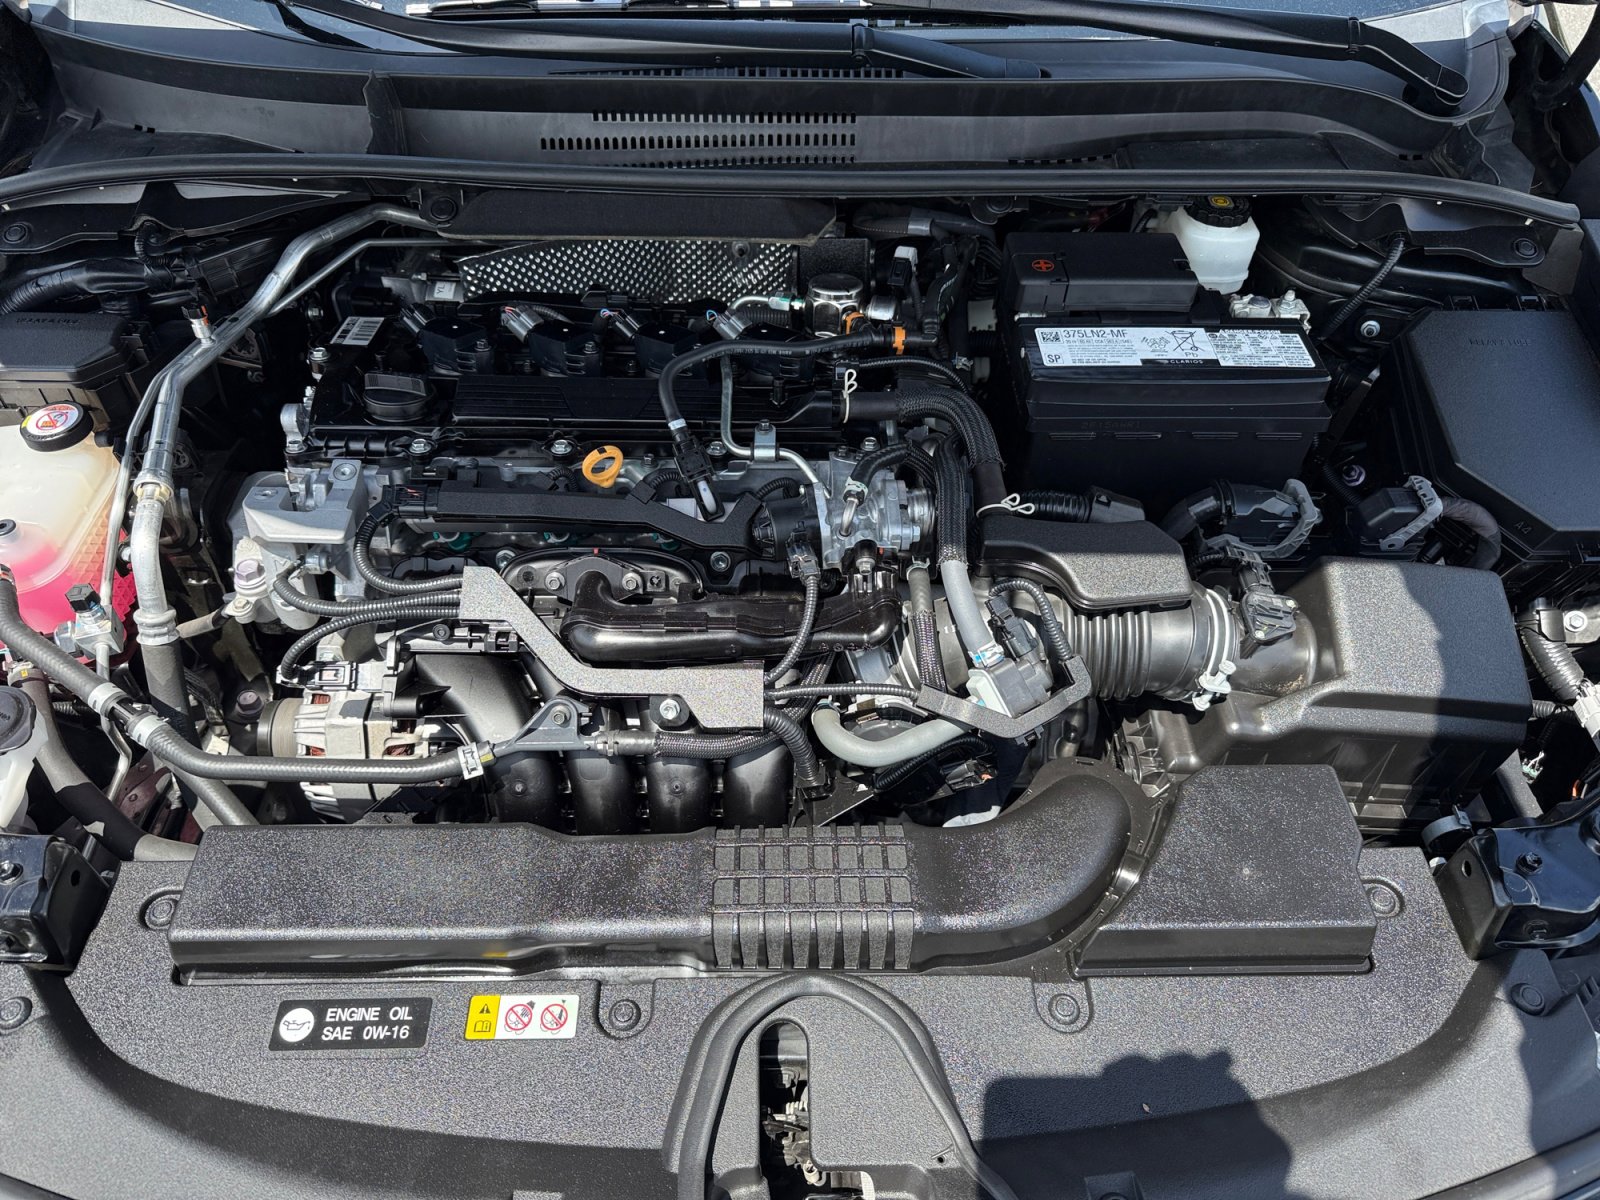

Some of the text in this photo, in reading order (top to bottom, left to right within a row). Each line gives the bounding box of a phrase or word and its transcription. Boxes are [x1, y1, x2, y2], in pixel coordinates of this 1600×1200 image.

[1063, 329, 1128, 338] 375LN2-MF
[1047, 354, 1061, 363] SP
[325, 1006, 413, 1022] ENGINE OIL
[321, 1025, 410, 1041] SAE 0W-16
